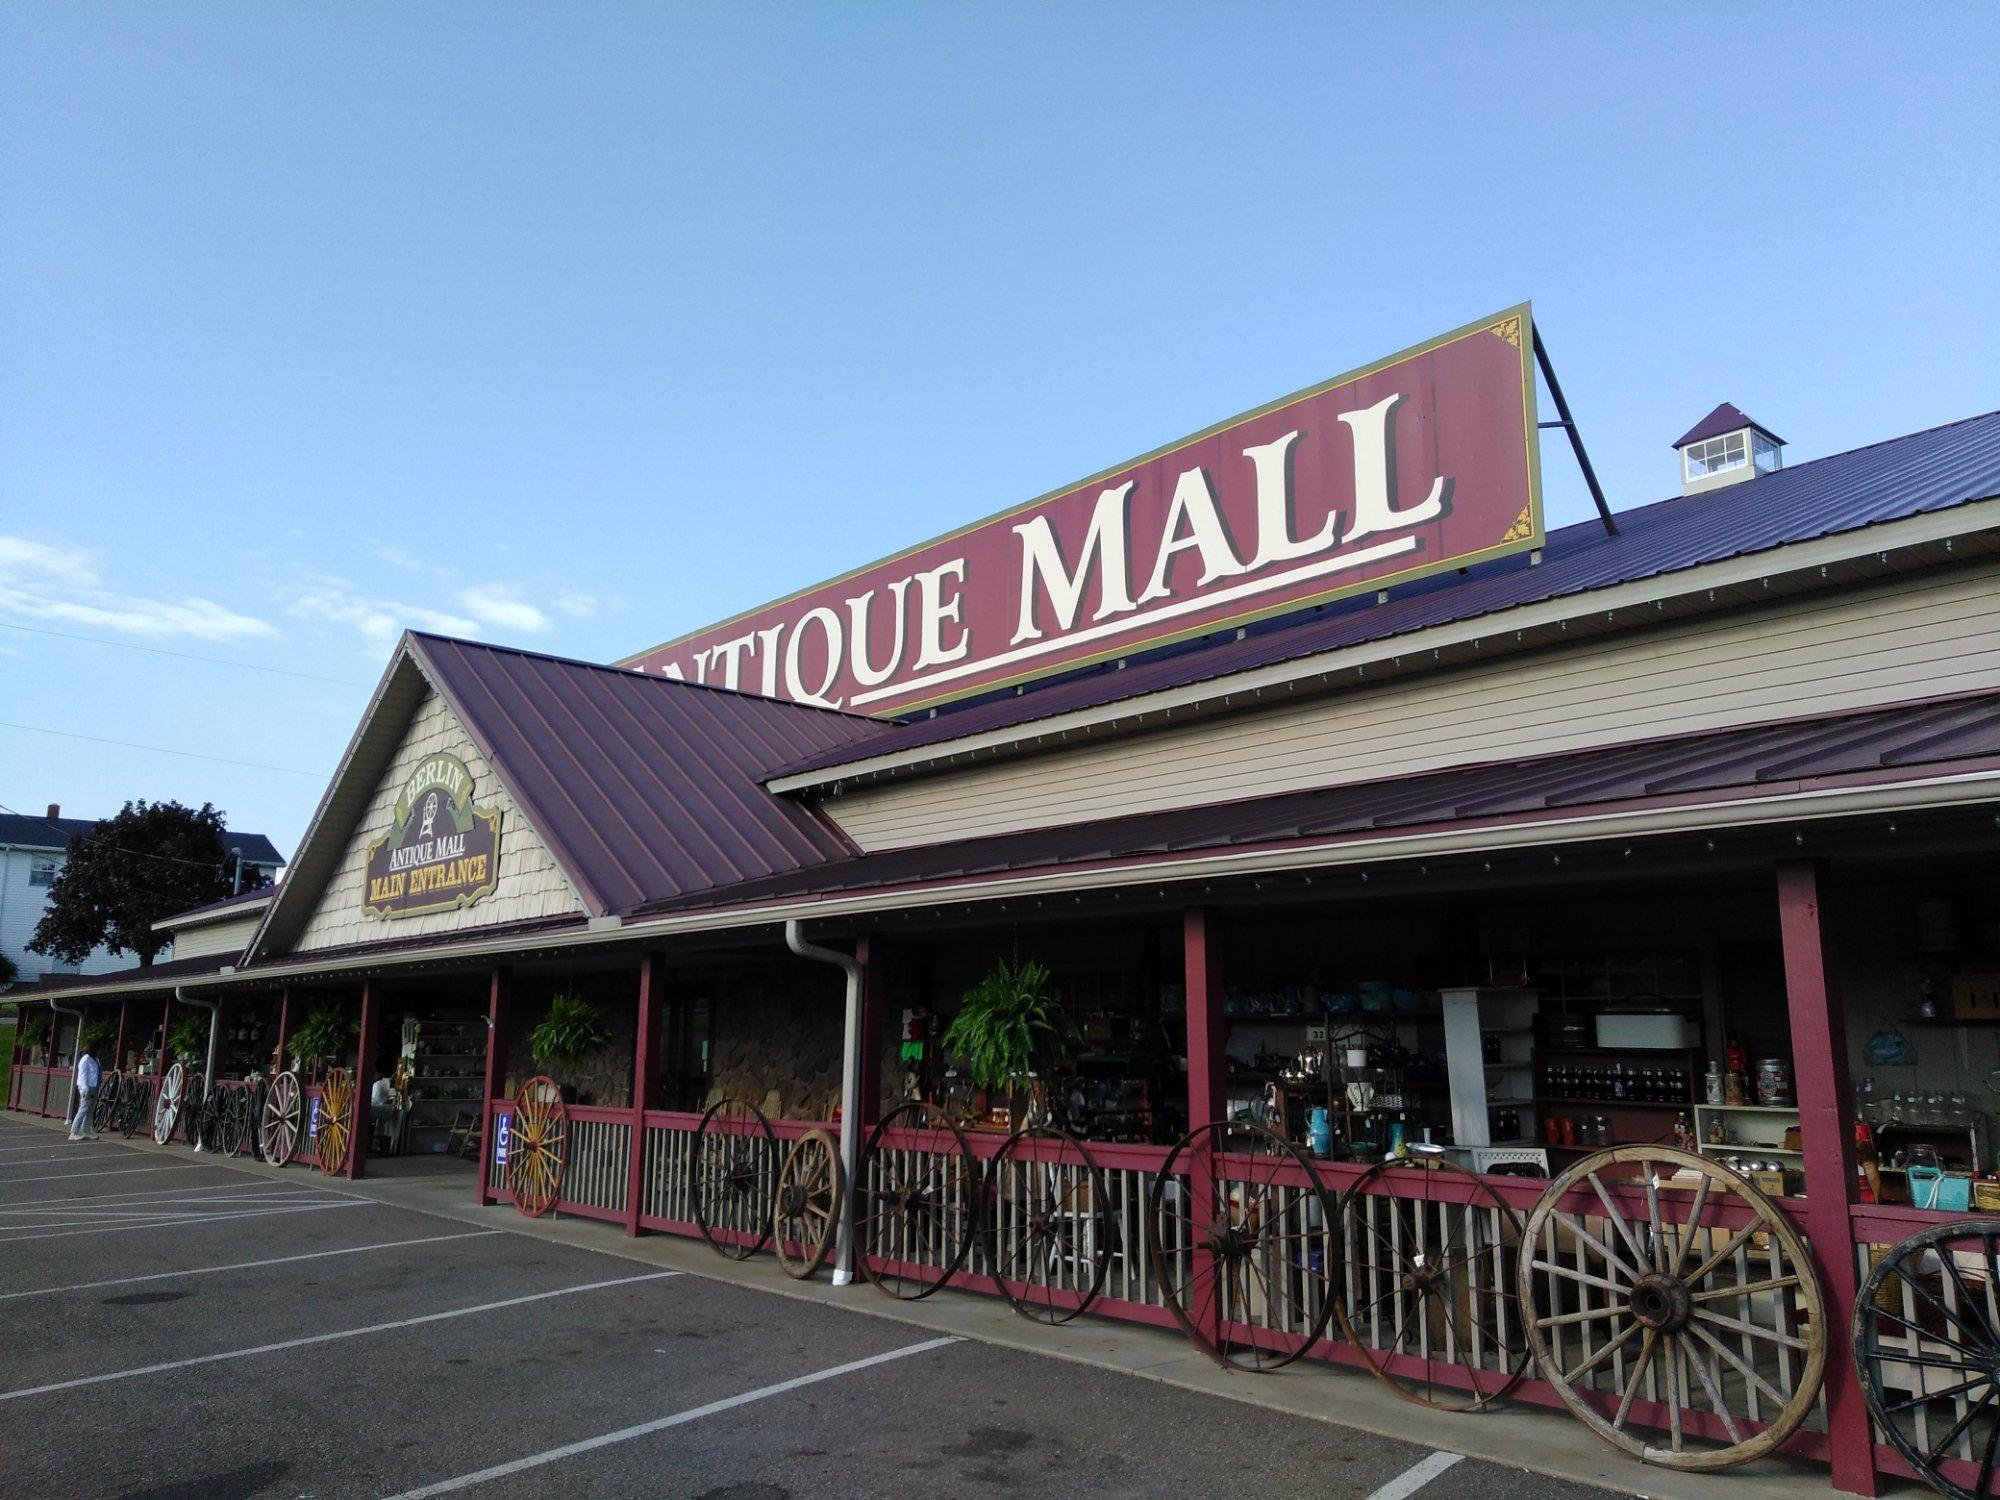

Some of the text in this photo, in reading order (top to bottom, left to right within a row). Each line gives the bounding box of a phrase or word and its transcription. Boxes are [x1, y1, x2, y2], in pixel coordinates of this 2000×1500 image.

[632, 393, 1444, 710] TIQUE MALL
[406, 760, 463, 807] BERLIN
[389, 833, 466, 867] ANTIQUE MALL
[370, 854, 487, 902] MAIN ENTRANCE
[1313, 1030, 1325, 1039] 32
